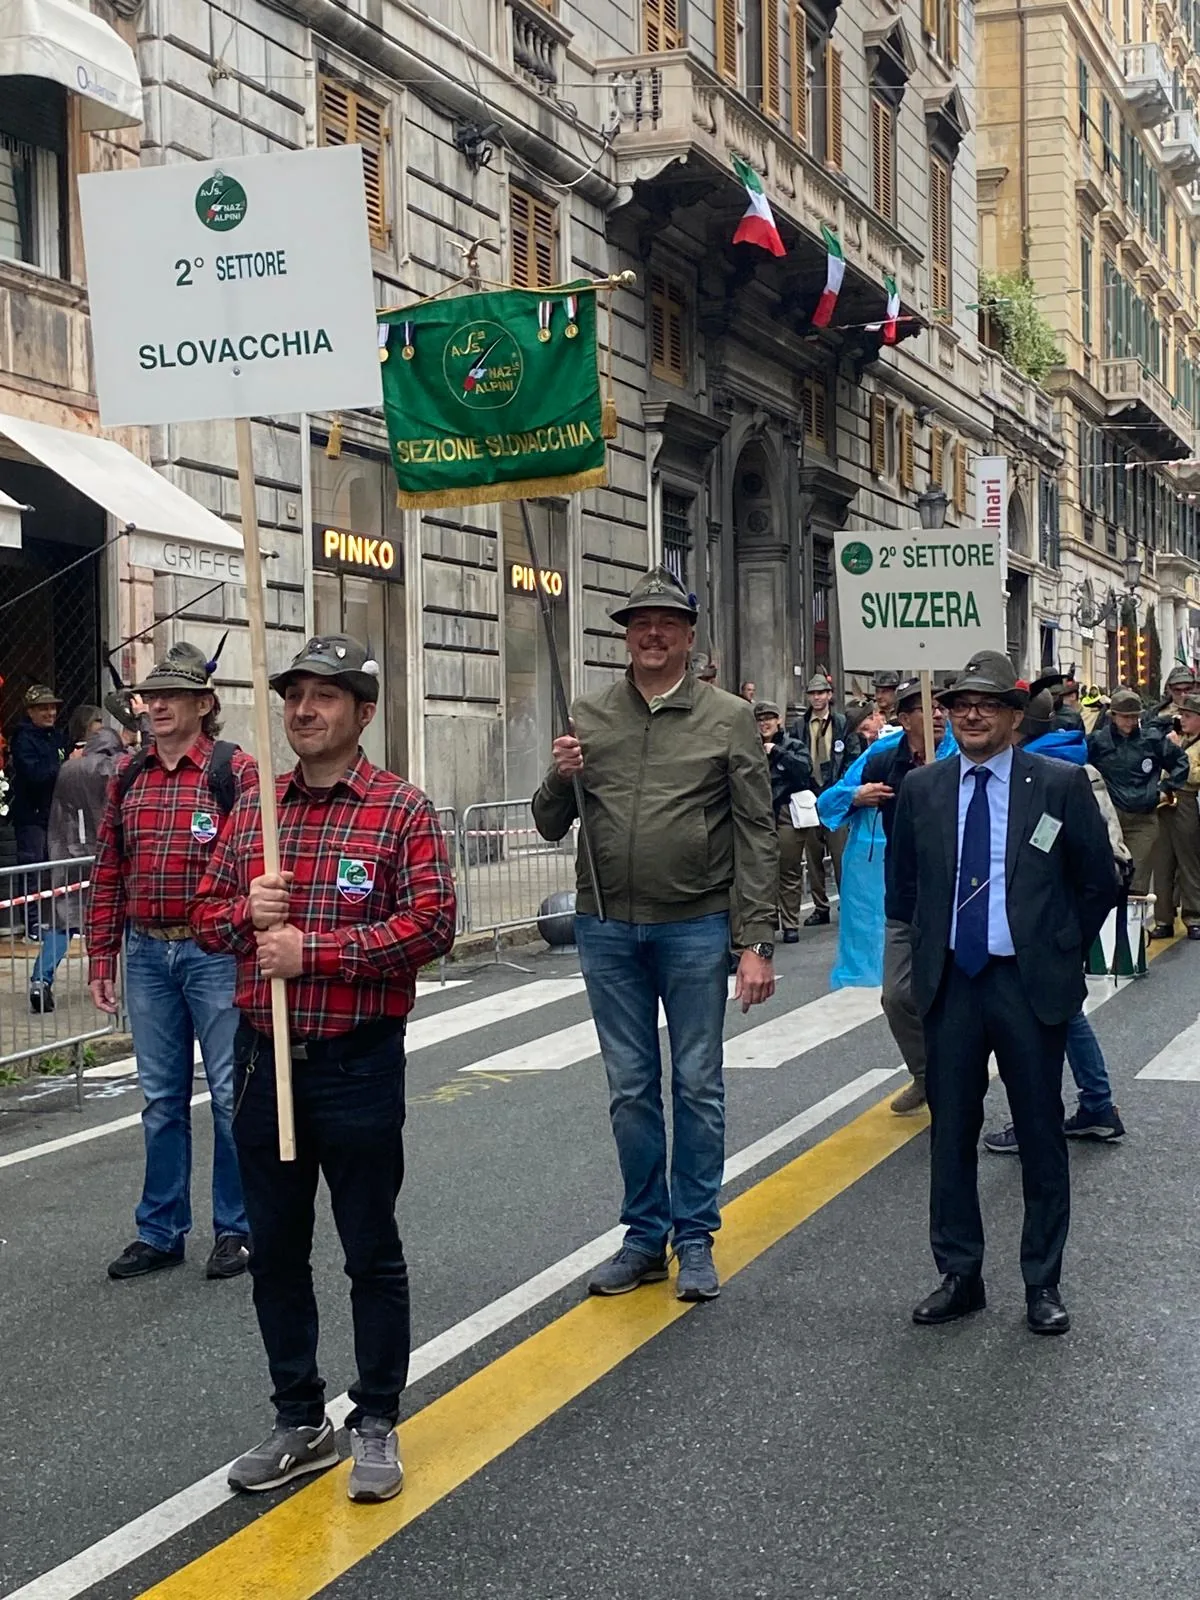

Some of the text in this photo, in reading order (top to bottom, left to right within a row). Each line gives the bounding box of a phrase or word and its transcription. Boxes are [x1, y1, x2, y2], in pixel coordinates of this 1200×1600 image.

[214, 213, 241, 222] ALPINI
[174, 250, 287, 286] 2° SETTORE
[138, 328, 333, 370] SLOVACCHIA
[475, 380, 514, 395] ALPINI
[397, 421, 595, 463] SEZIONE SLOVACCHIA
[163, 543, 240, 577] GRIFFE
[324, 529, 394, 570] PINKO
[903, 544, 995, 568] SETTORE
[861, 591, 982, 629] SVIZZERA
